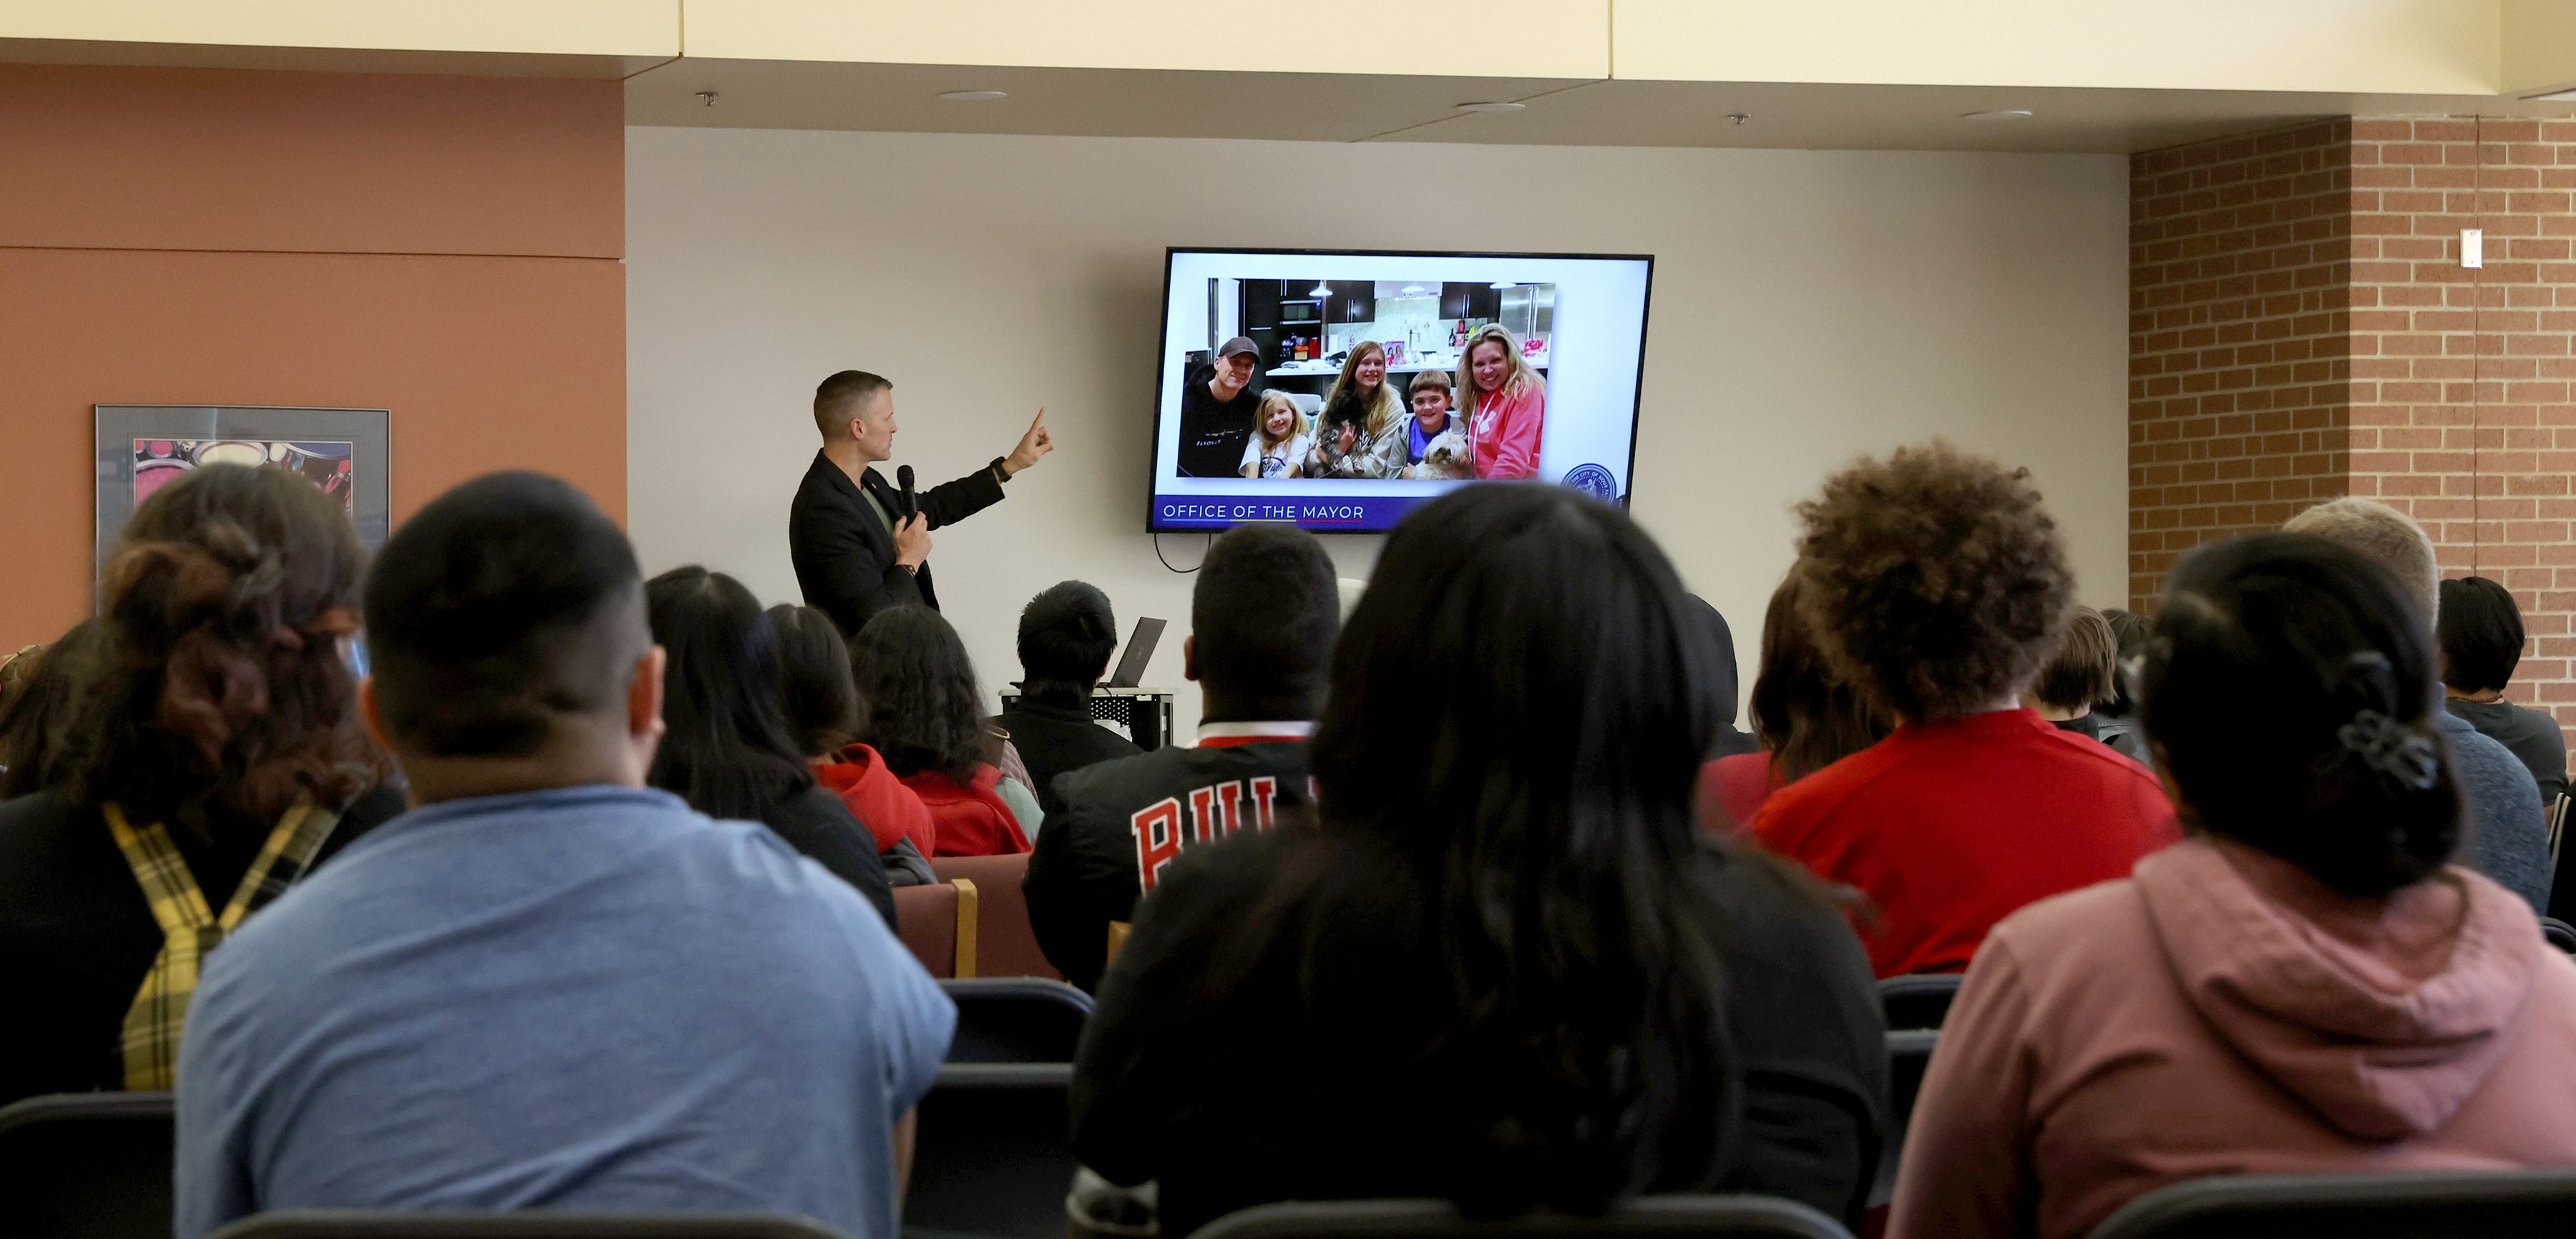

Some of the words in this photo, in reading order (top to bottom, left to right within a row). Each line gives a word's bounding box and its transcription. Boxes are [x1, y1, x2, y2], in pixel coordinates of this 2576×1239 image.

[1571, 474, 1580, 483] THE
[1163, 504, 1226, 518] OFFICE
[1233, 505, 1257, 518] OF
[1262, 505, 1297, 519] THE
[1302, 506, 1364, 519] MAYOR
